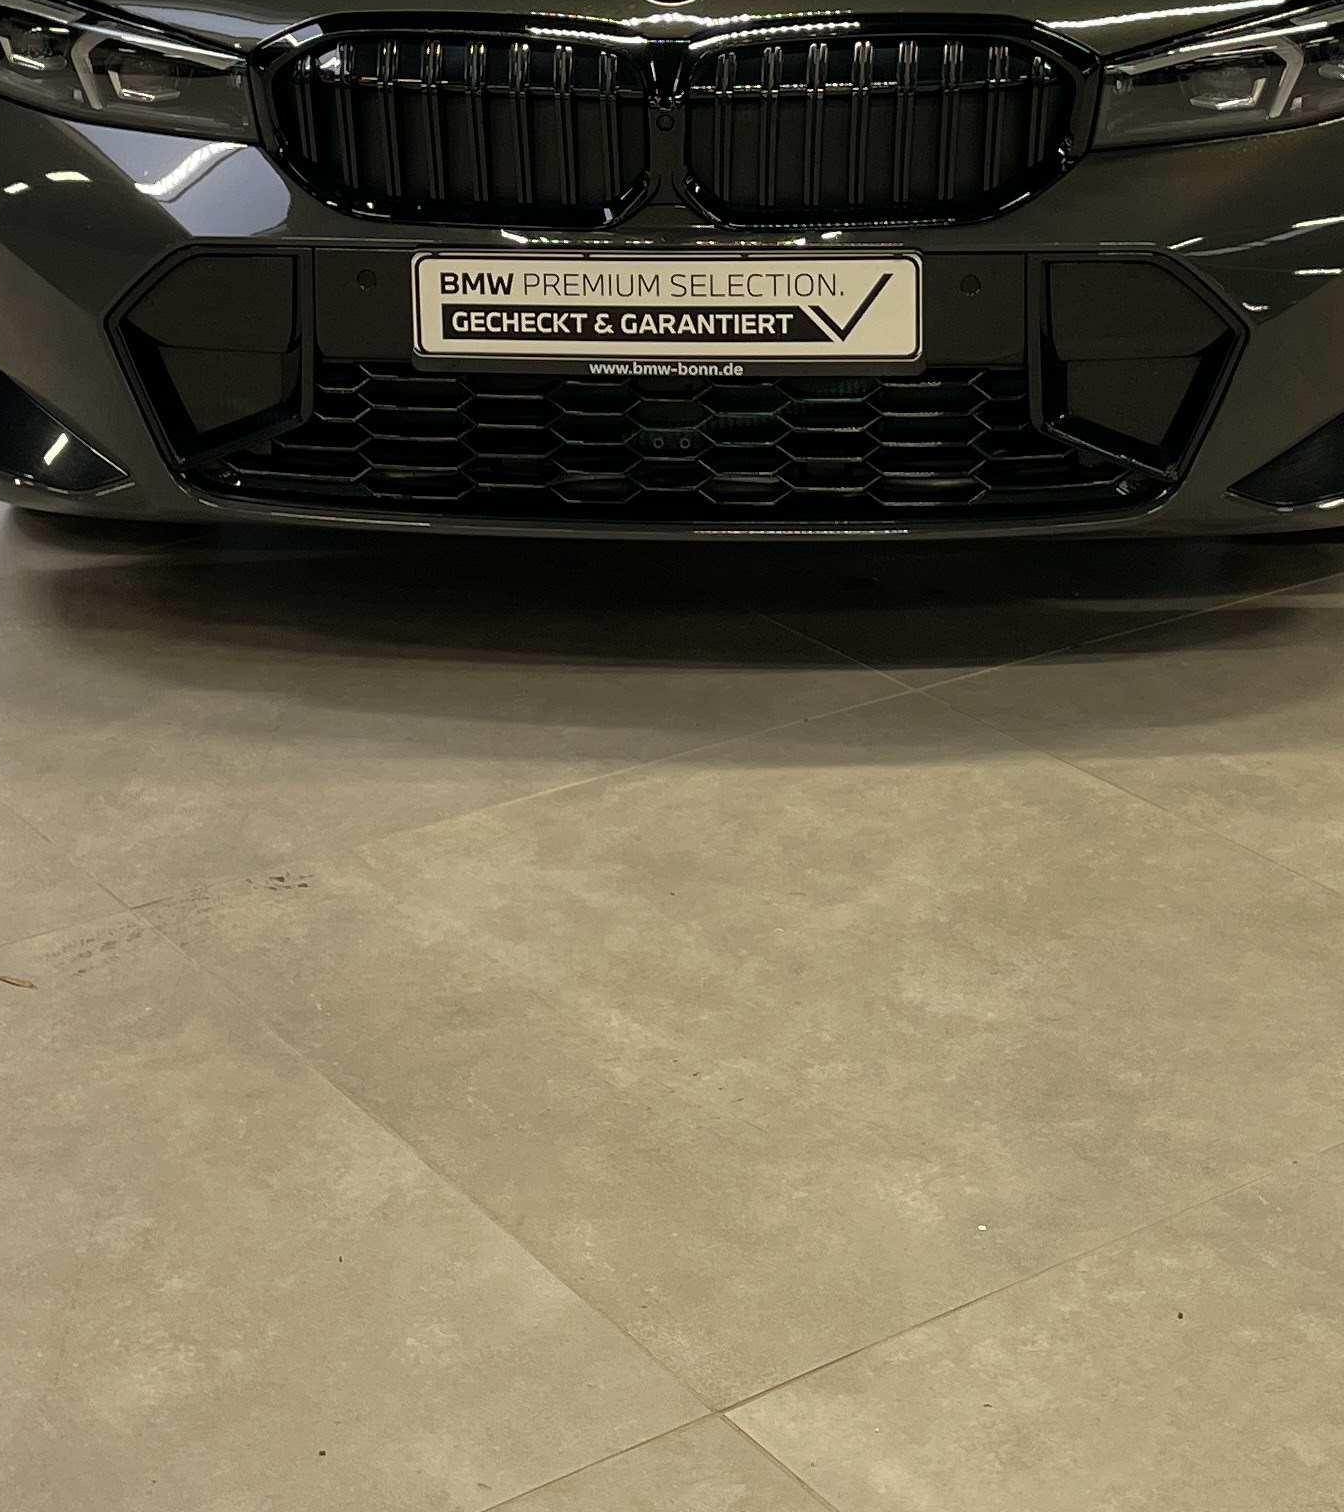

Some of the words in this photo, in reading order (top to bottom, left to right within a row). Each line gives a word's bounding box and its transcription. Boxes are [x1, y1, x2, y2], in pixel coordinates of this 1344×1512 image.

[439, 272, 514, 295] BMW
[523, 273, 658, 297] PREMIUM
[670, 273, 845, 297] SELECTION.
[451, 311, 584, 334] GECHECKT
[593, 312, 613, 334] &
[620, 312, 794, 335] GARANTIERT
[588, 361, 744, 377] www.bmw-bonn.de
